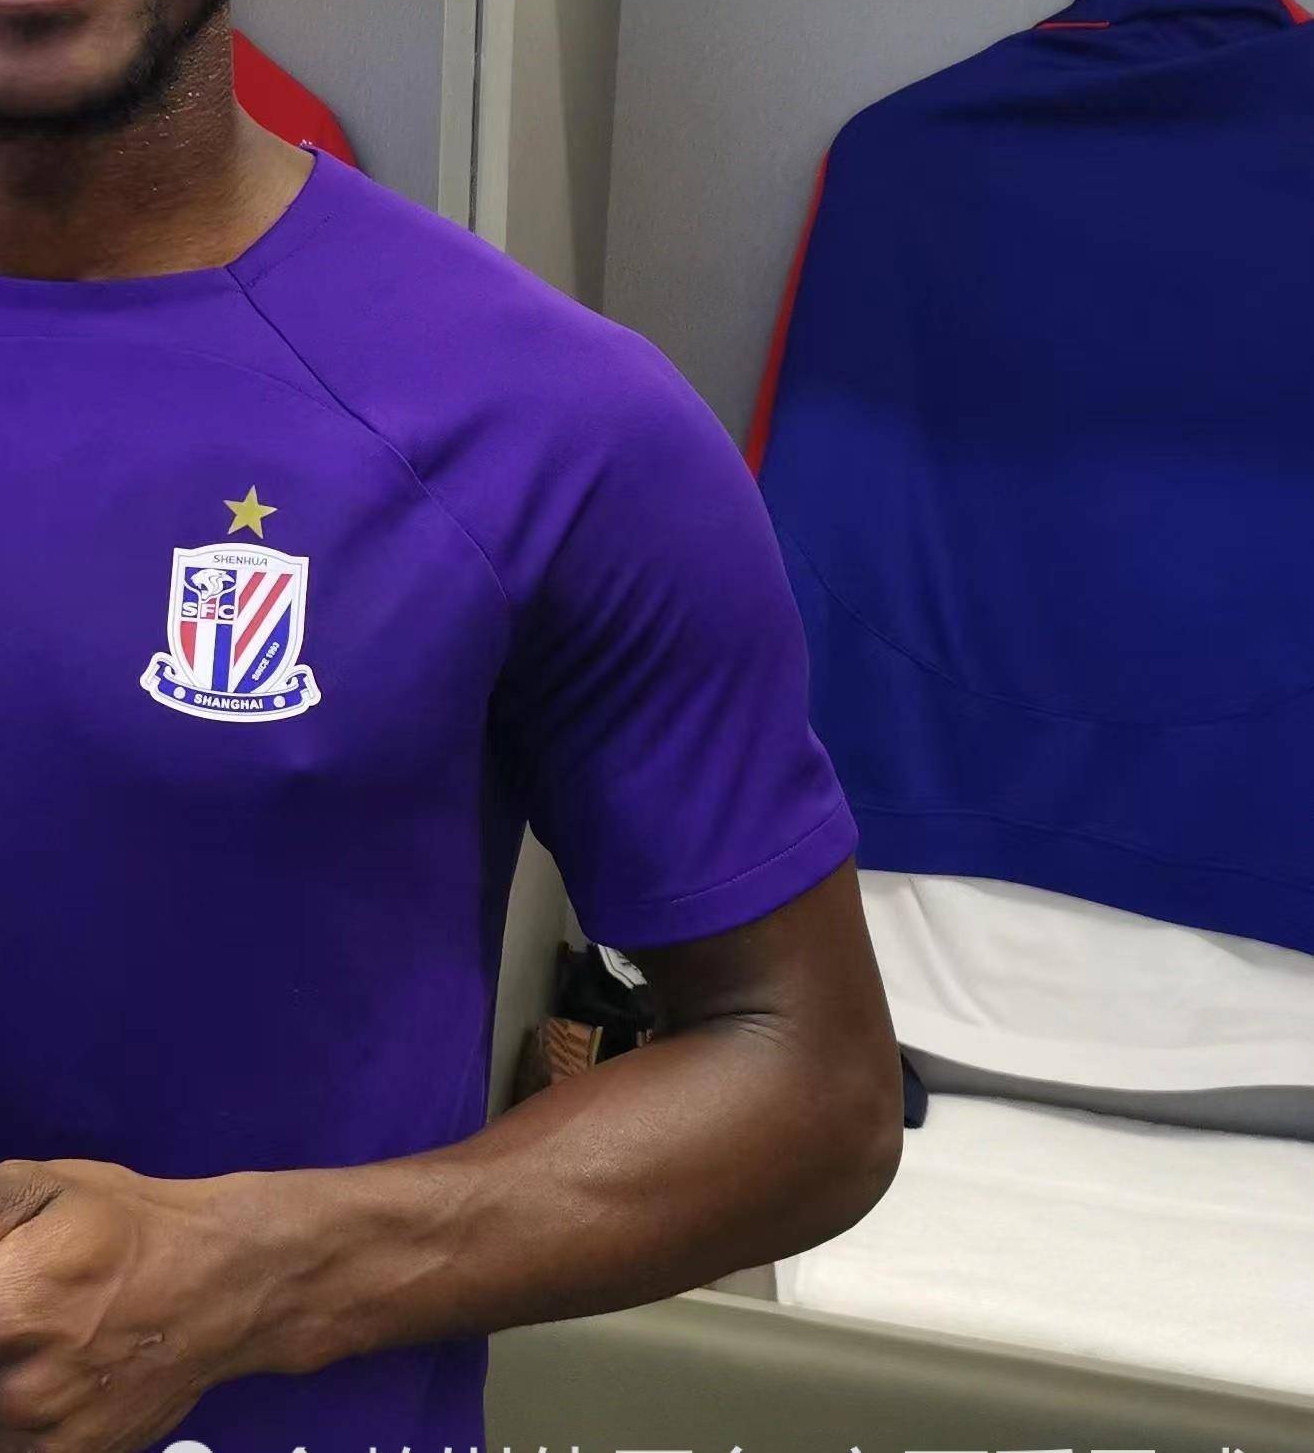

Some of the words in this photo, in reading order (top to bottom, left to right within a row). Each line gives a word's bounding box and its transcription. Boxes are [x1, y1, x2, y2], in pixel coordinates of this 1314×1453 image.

[213, 554, 268, 566] SHENHUA
[182, 601, 235, 619] SFC
[193, 693, 264, 710] SHANGHAI
